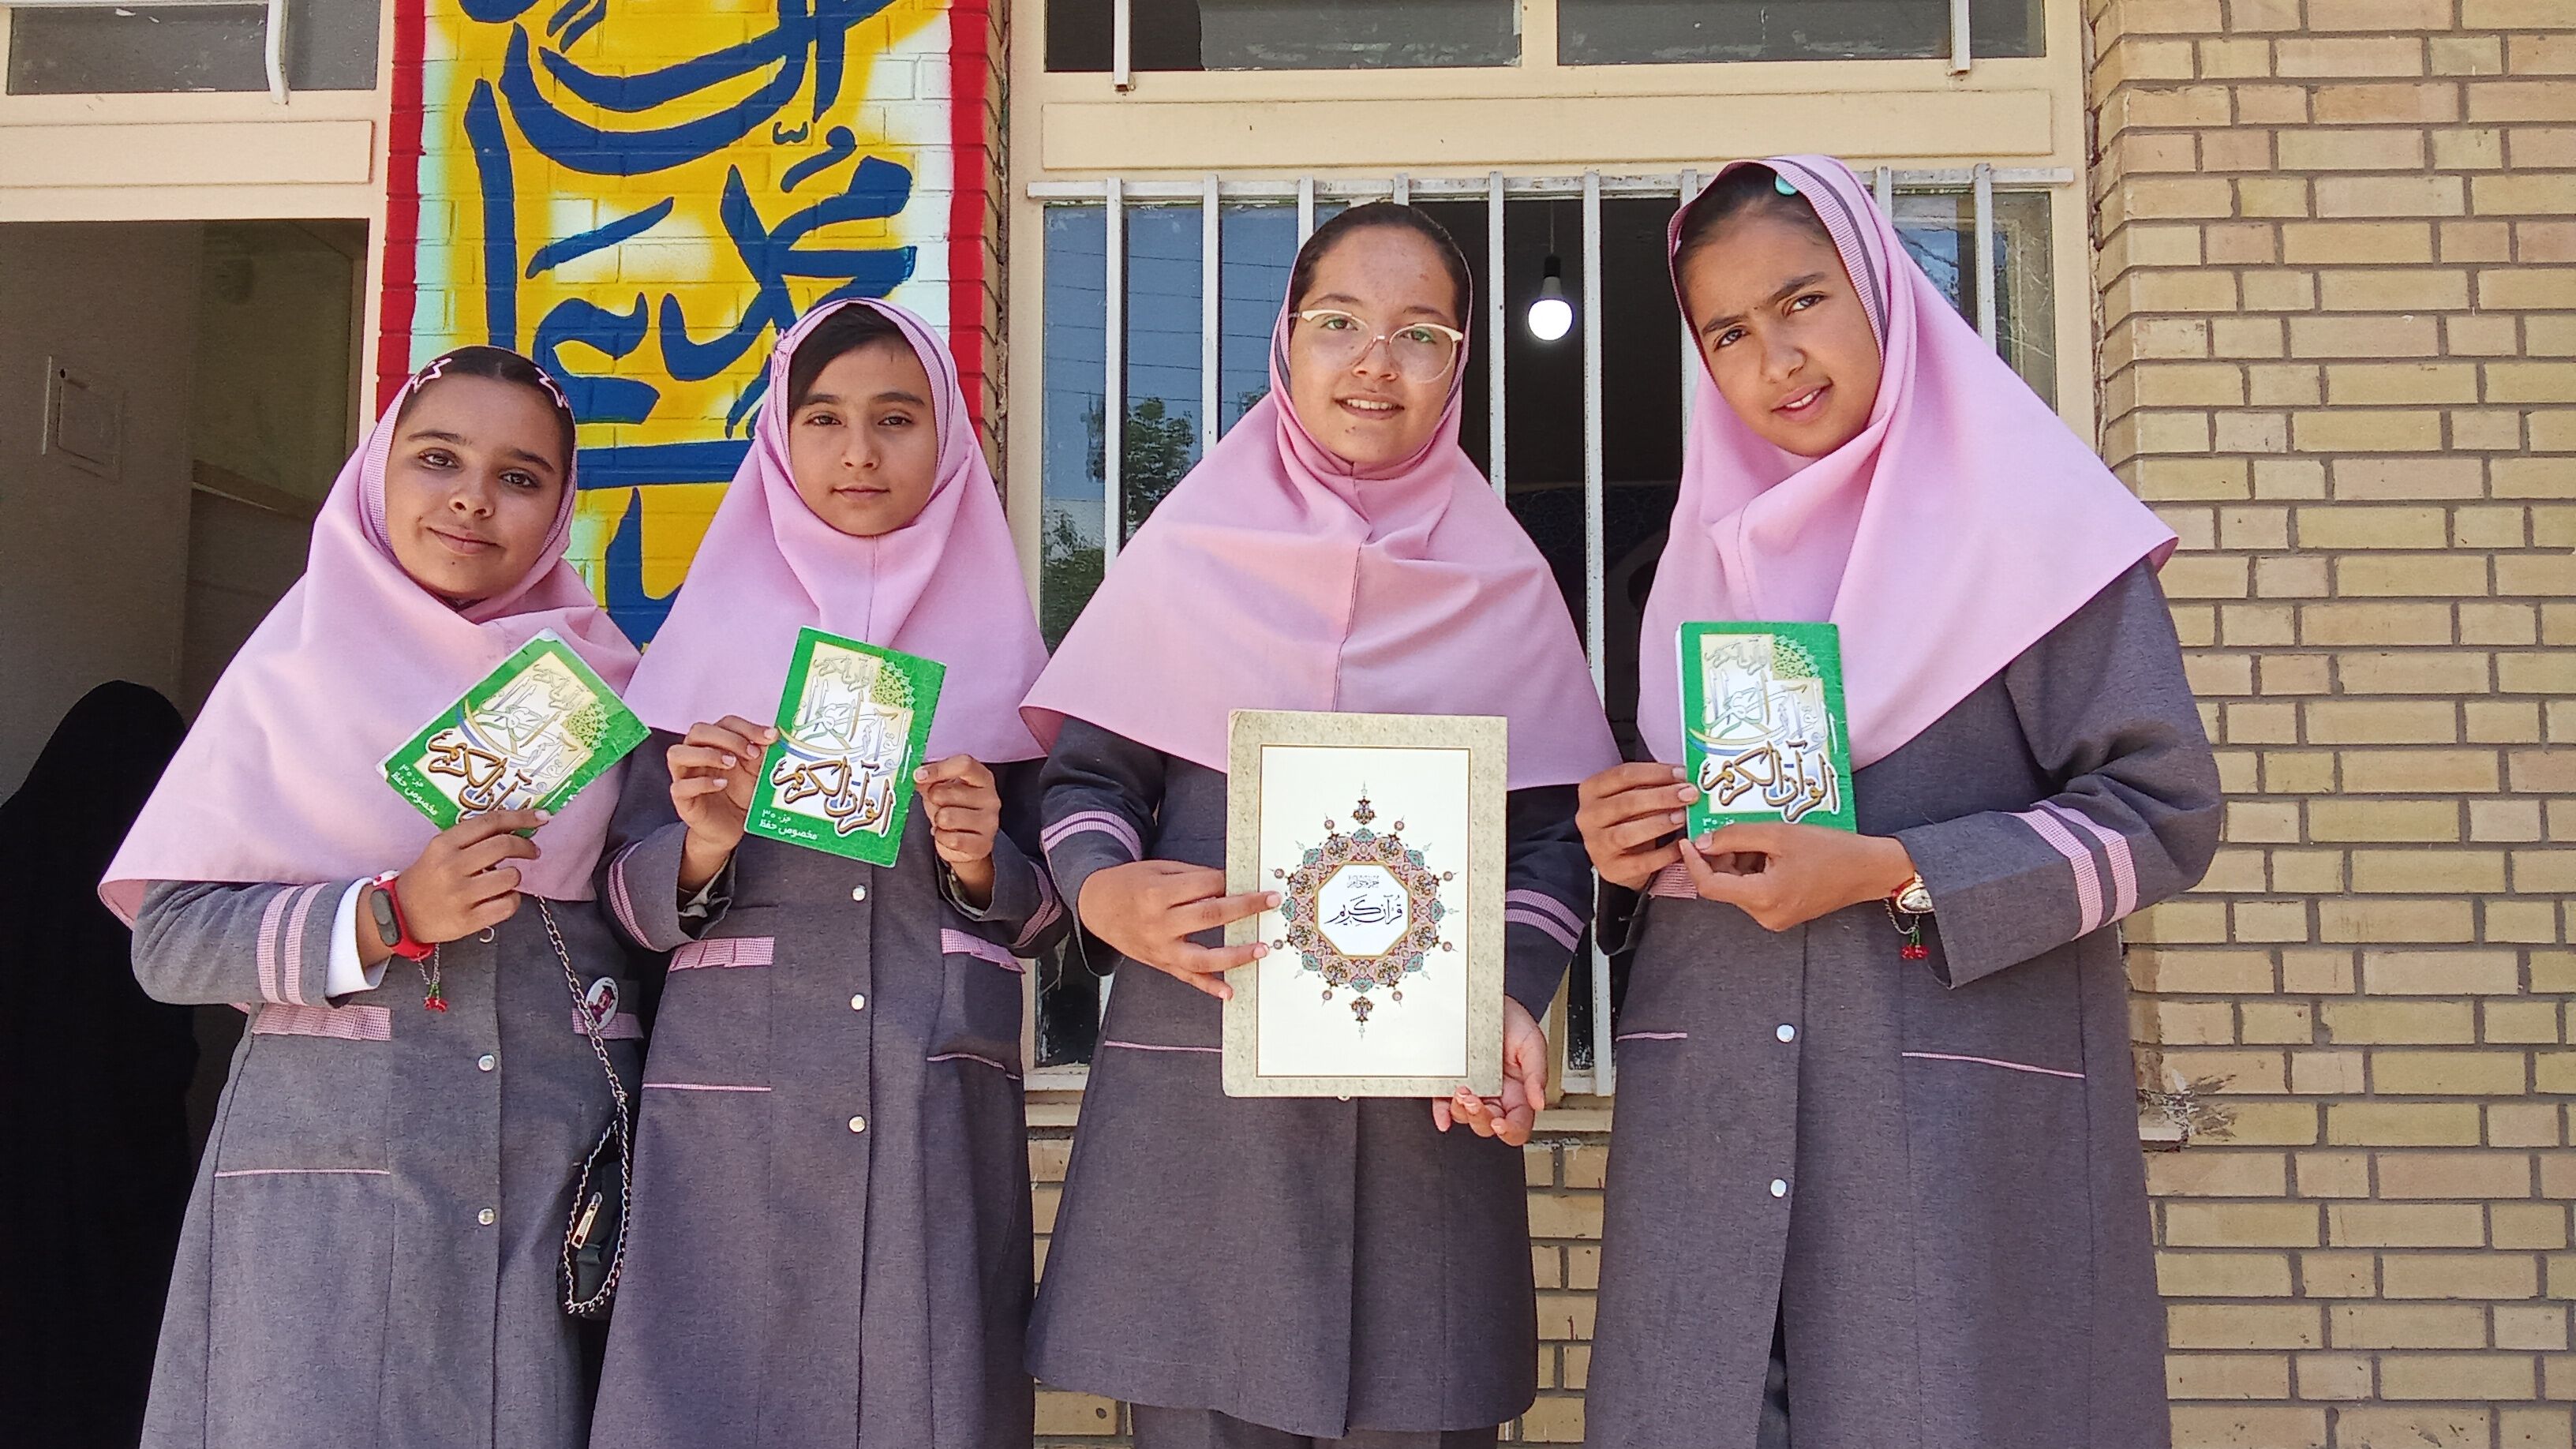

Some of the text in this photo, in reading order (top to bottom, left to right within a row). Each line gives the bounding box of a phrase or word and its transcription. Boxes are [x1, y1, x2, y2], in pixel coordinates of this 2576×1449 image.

[391, 771, 438, 816] مخصوص حفظ
[762, 809, 776, 818] ۳۰
[759, 819, 818, 840] مخصوص حفظ
[1702, 818, 1717, 826] ۳۰
